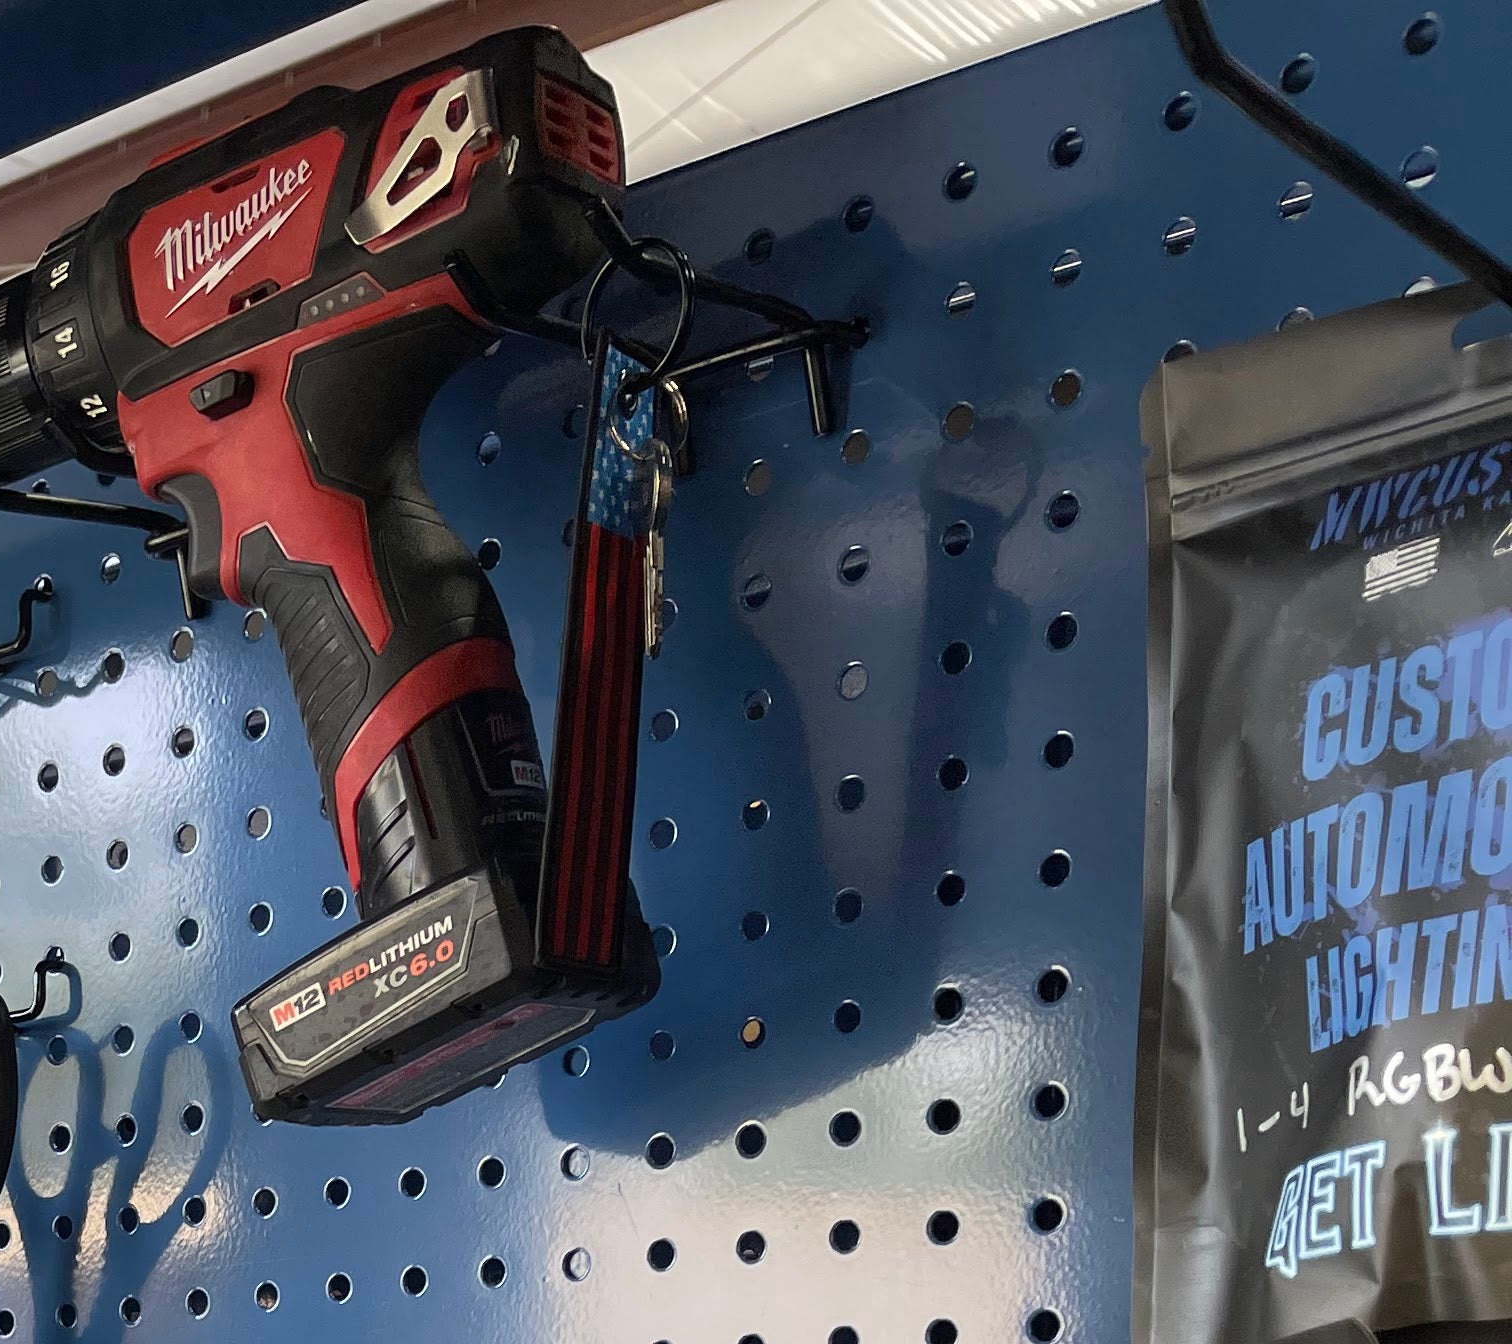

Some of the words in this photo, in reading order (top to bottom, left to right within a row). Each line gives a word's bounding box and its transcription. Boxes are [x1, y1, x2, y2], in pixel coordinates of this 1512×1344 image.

[154, 158, 313, 291] Milwaukee
[49, 260, 70, 290] 16
[54, 326, 78, 359] 14
[79, 393, 108, 418] 12
[1363, 504, 1466, 550] WICHITA
[272, 988, 321, 1027] M12
[327, 915, 454, 996] REDLITHIUM
[1348, 1042, 1512, 1117] RGBW
[1265, 1139, 1387, 1279] GET
